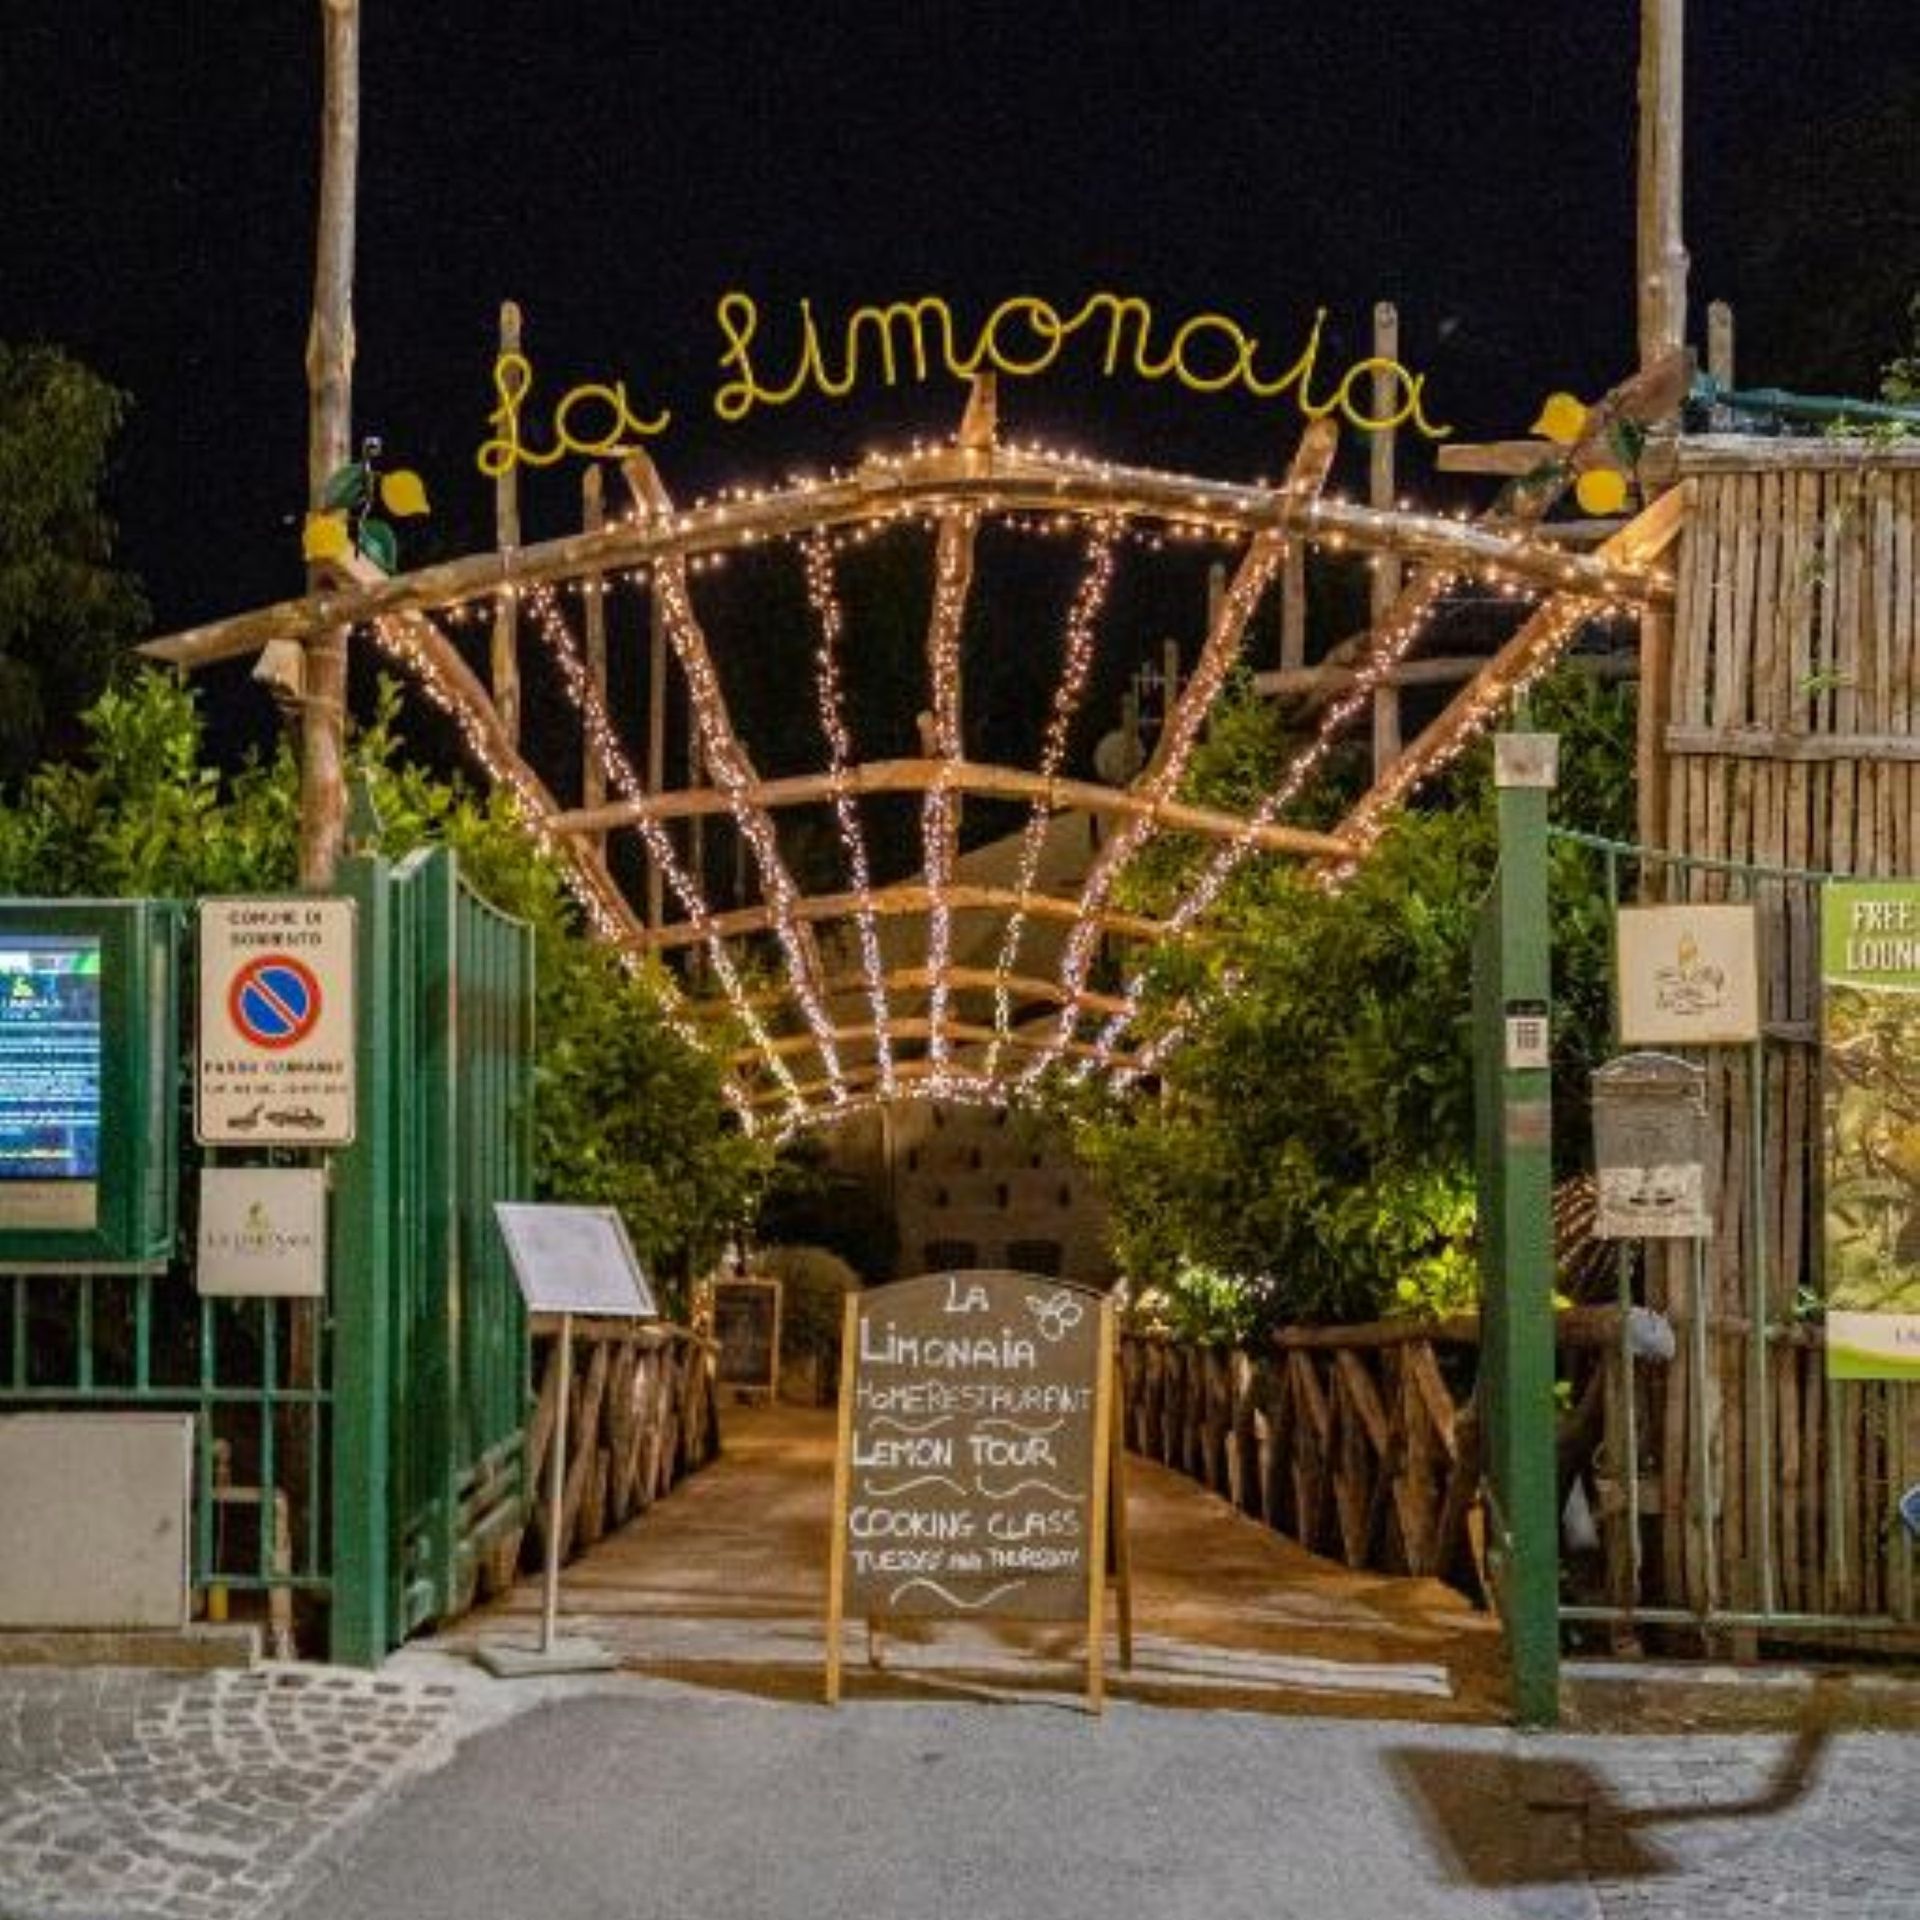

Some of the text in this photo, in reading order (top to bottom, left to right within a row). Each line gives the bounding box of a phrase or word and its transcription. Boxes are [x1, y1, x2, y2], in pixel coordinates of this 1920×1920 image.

[477, 293, 1452, 475] La Limonaia
[1853, 901, 1912, 929] FREE
[944, 1276, 990, 1312] LA
[852, 1429, 952, 1468] LEMON
[850, 1505, 1080, 1540] COOKING CLASS
